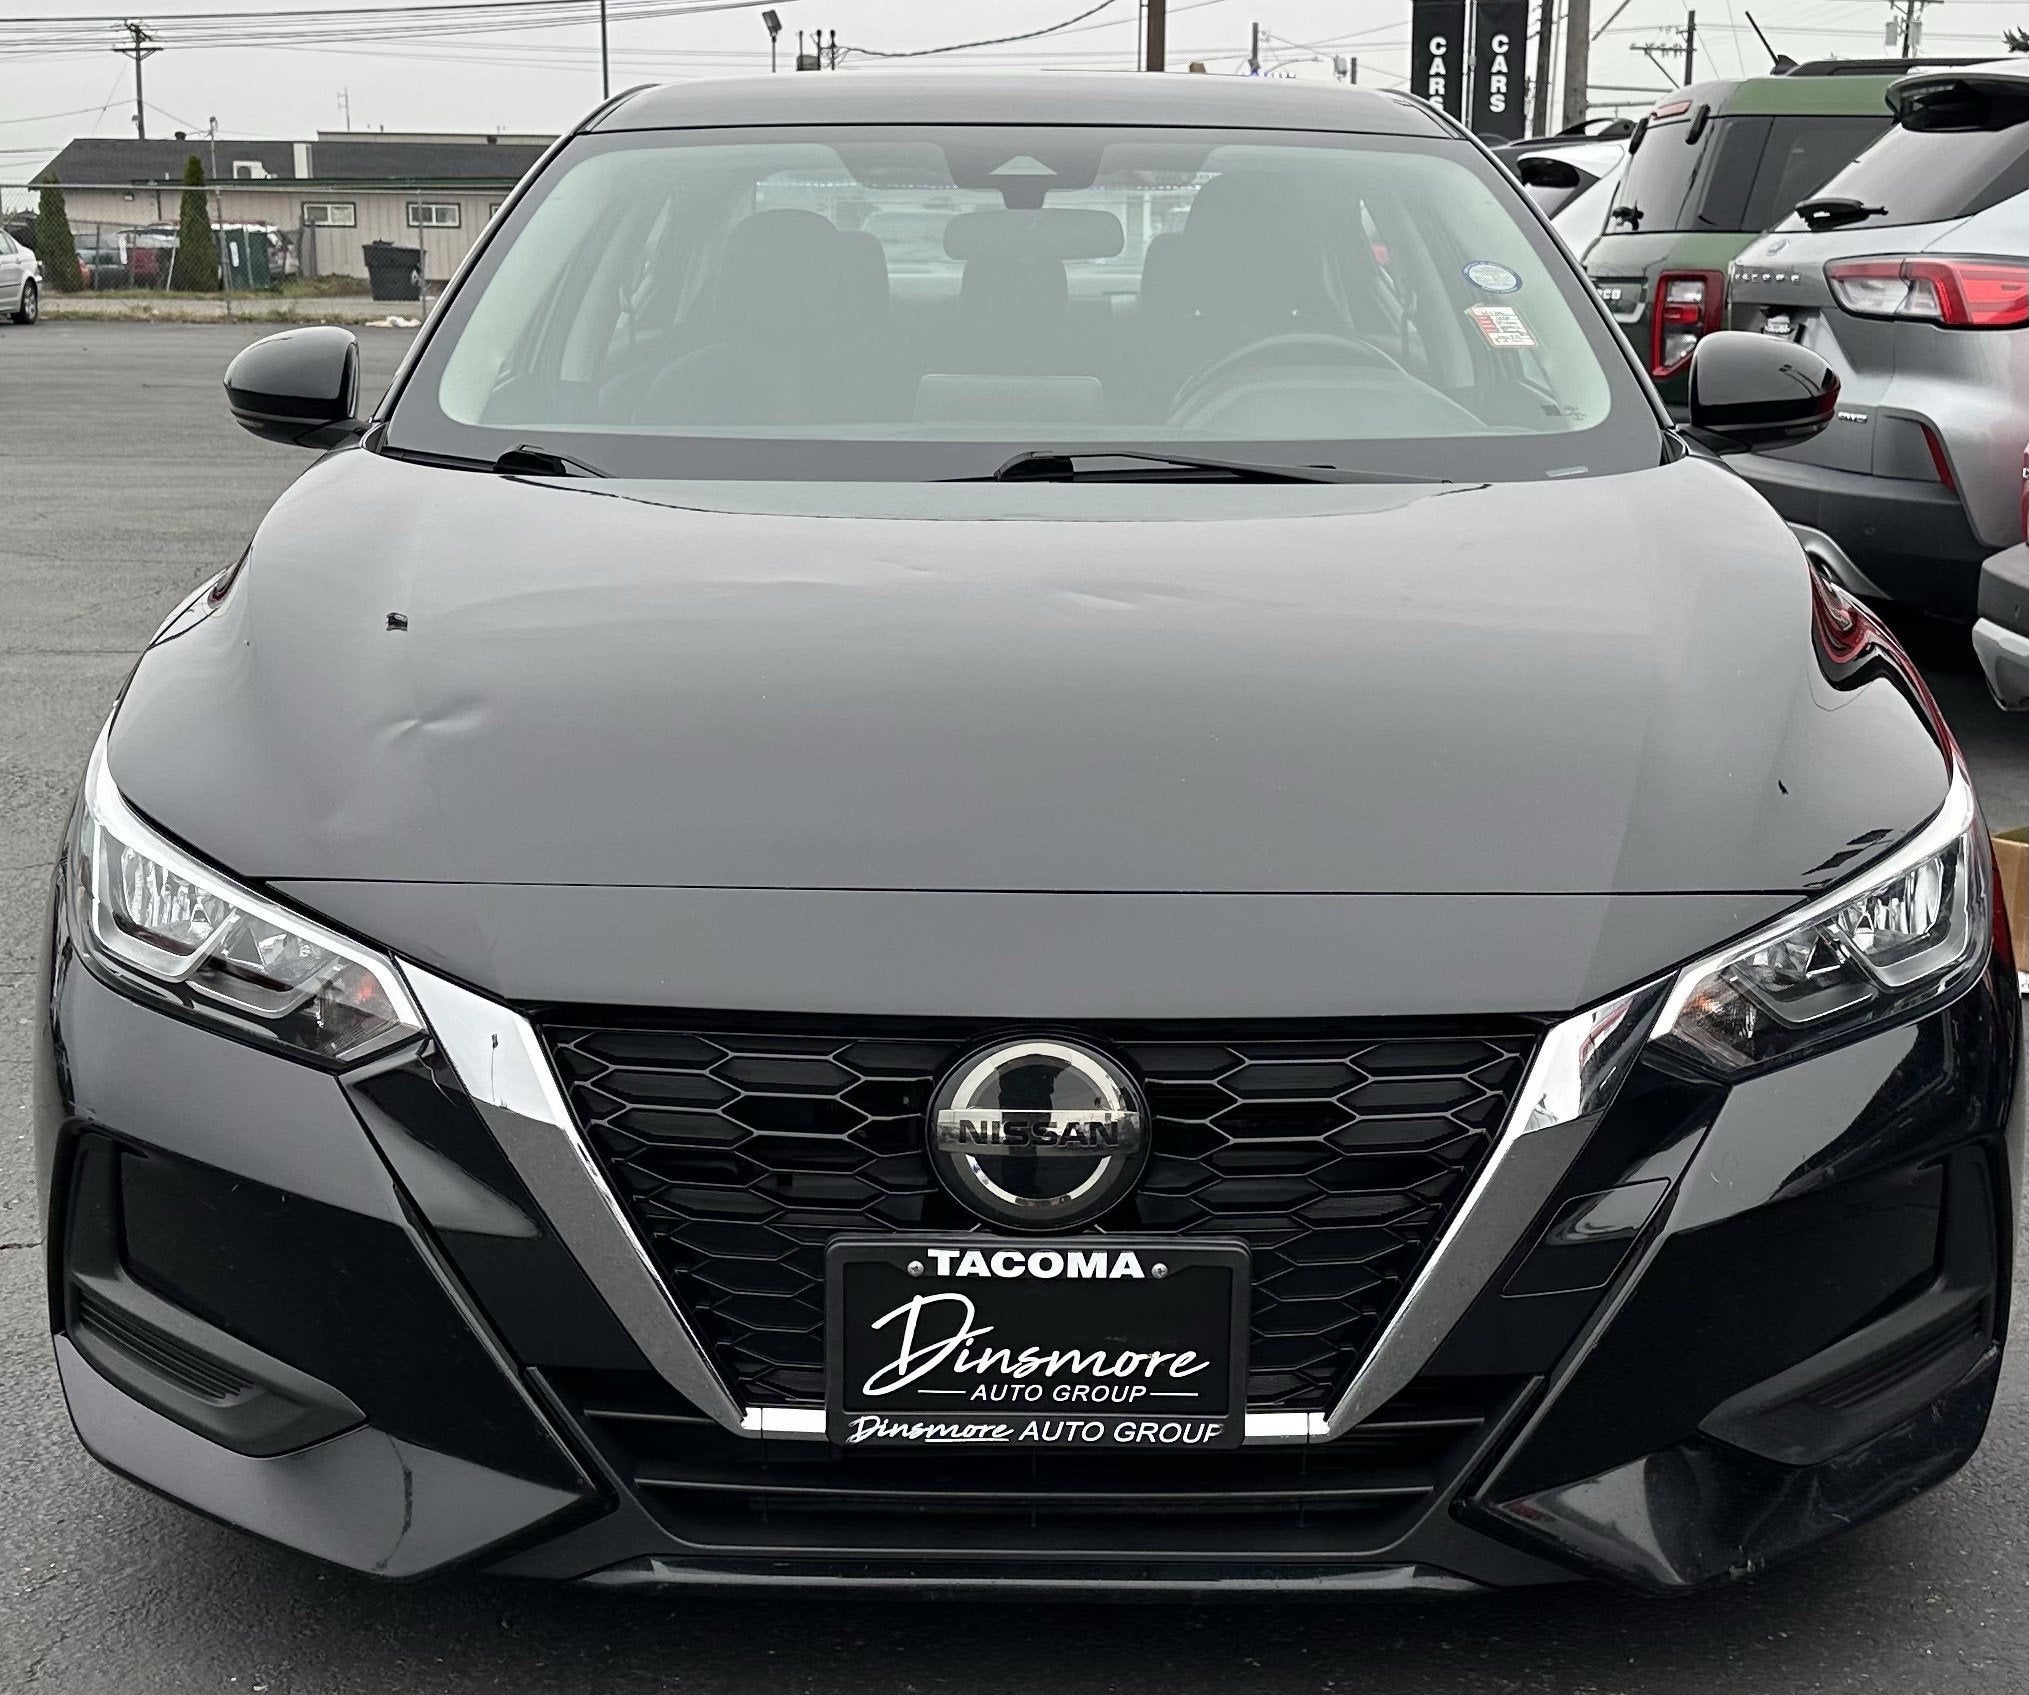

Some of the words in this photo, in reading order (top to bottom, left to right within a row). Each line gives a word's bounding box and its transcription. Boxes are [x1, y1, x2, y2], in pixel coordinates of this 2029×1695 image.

[1489, 34, 1509, 113] CARS
[959, 1119, 1118, 1147] NISSAN
[927, 1248, 1145, 1280] TACOMA
[862, 1292, 1210, 1396] Dinsmore
[970, 1384, 1043, 1402] AUTO
[1052, 1385, 1147, 1403] GROUP
[846, 1415, 1014, 1443] Dinsmore
[1018, 1420, 1105, 1442] AUTO
[1113, 1422, 1224, 1444] GROUP
